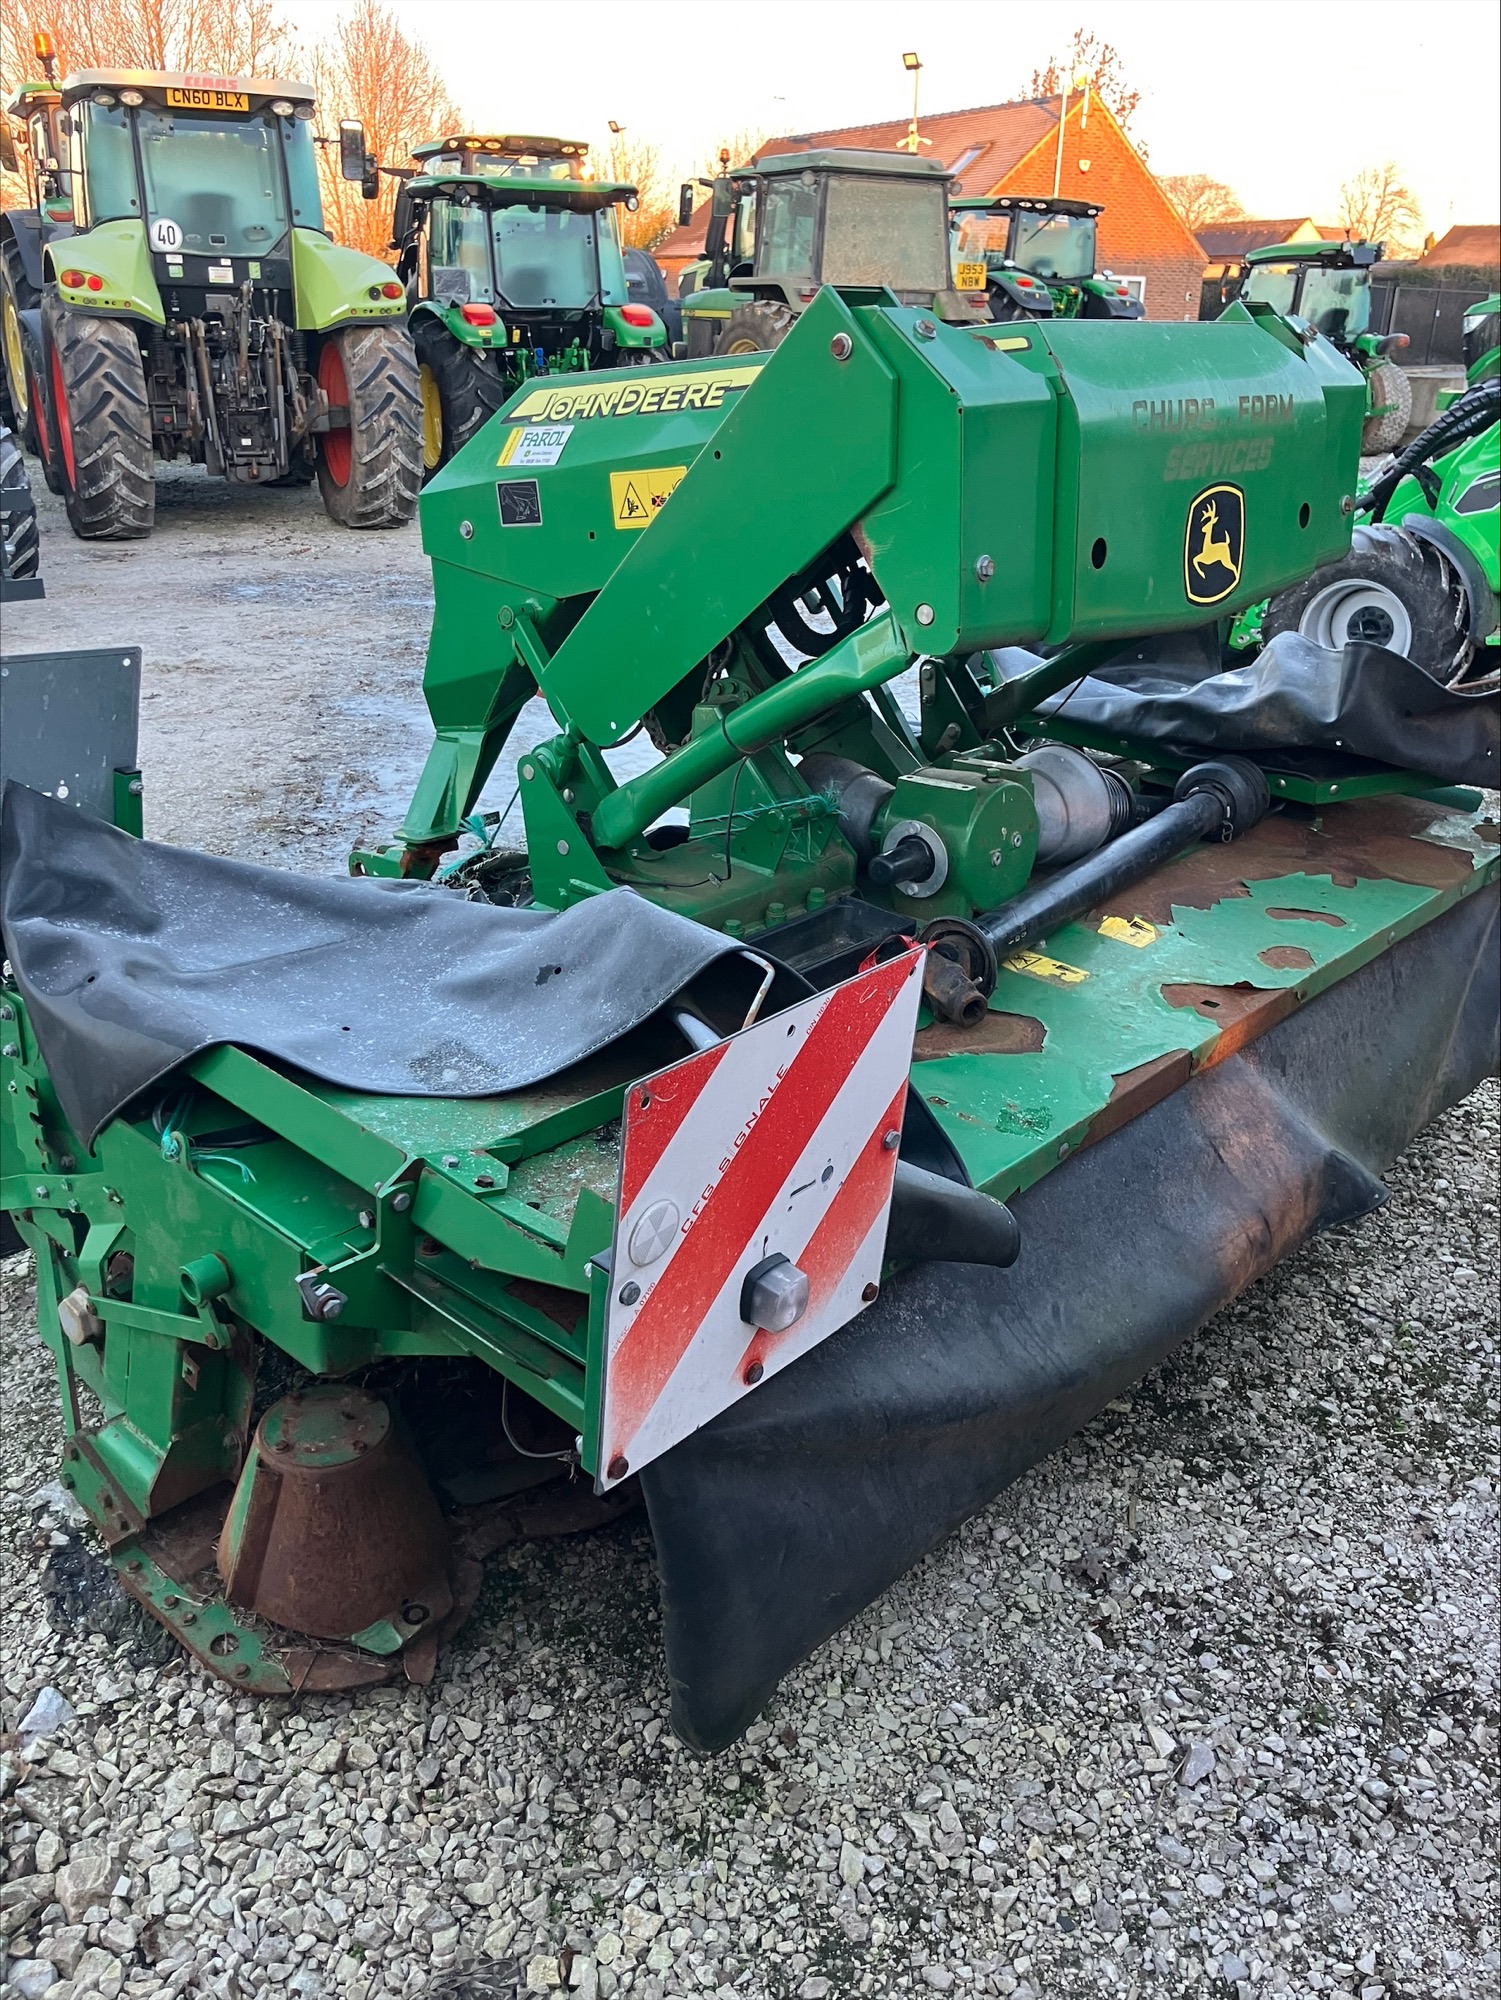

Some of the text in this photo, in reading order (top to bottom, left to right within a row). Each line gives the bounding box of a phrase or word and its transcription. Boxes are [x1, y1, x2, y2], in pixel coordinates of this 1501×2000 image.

[184, 75, 238, 91] CLAAS
[172, 89, 243, 108] CN60 BLX
[157, 224, 176, 246] 40
[959, 264, 984, 275] J953
[520, 430, 566, 448] FAROL
[1163, 436, 1275, 482] SERVICES
[806, 1019, 817, 1035] DIN
[680, 1183, 715, 1234] CFG
